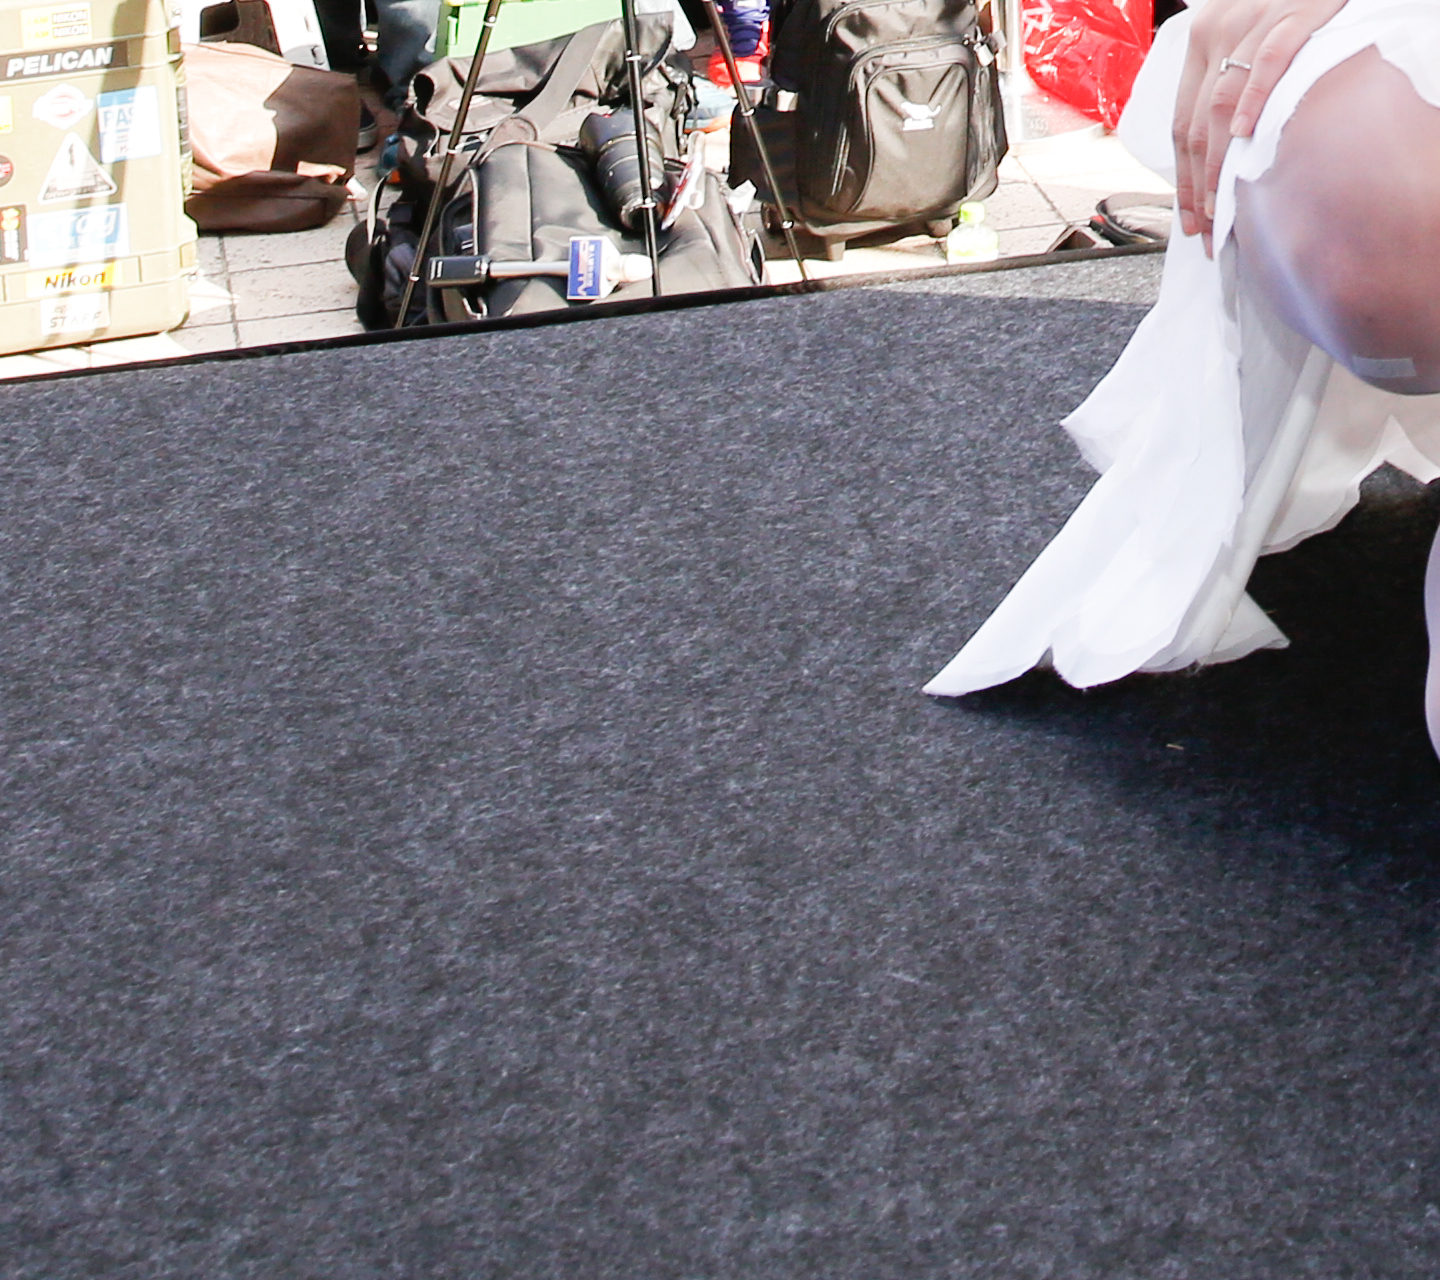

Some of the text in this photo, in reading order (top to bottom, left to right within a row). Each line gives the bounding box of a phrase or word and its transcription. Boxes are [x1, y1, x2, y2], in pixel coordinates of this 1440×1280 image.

[52, 10, 87, 24] NIKON
[53, 24, 88, 38] NIKON
[6, 46, 113, 78] PELICAN
[45, 271, 106, 289] Nikon
